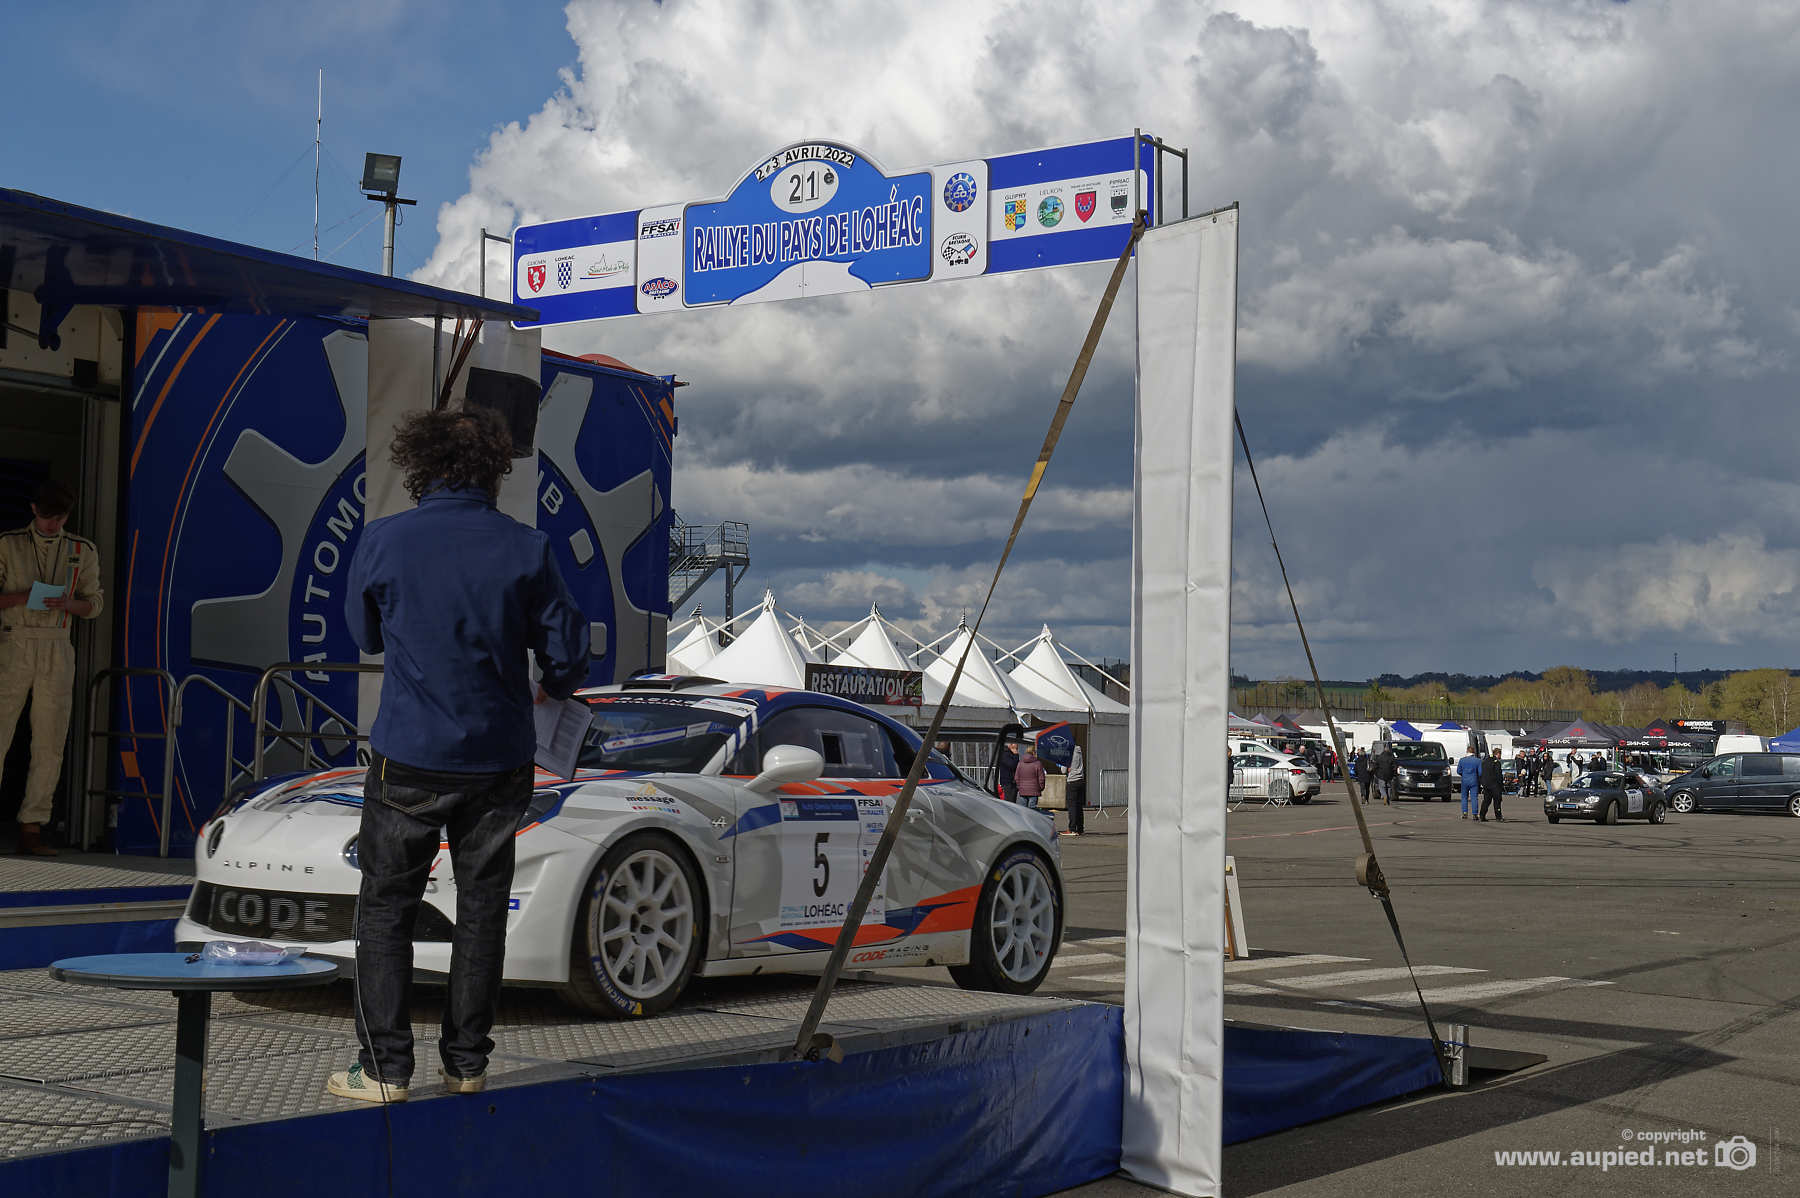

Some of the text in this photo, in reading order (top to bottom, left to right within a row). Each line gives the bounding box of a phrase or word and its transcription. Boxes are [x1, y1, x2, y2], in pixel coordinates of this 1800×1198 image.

[785, 147, 821, 163] AVRIL
[824, 147, 854, 166] 2022
[641, 222, 676, 236] FFSA
[694, 184, 923, 272] RALLYE DU PAYS DE LOHÉAC
[302, 472, 367, 683] AUTOMO
[811, 672, 905, 697] RESTAURATION
[625, 796, 676, 805] message
[222, 860, 315, 875] ALPINE
[812, 831, 831, 898] 5
[219, 890, 330, 933] CODE
[803, 902, 844, 919] LOHÉAC
[851, 949, 888, 964] CODE
